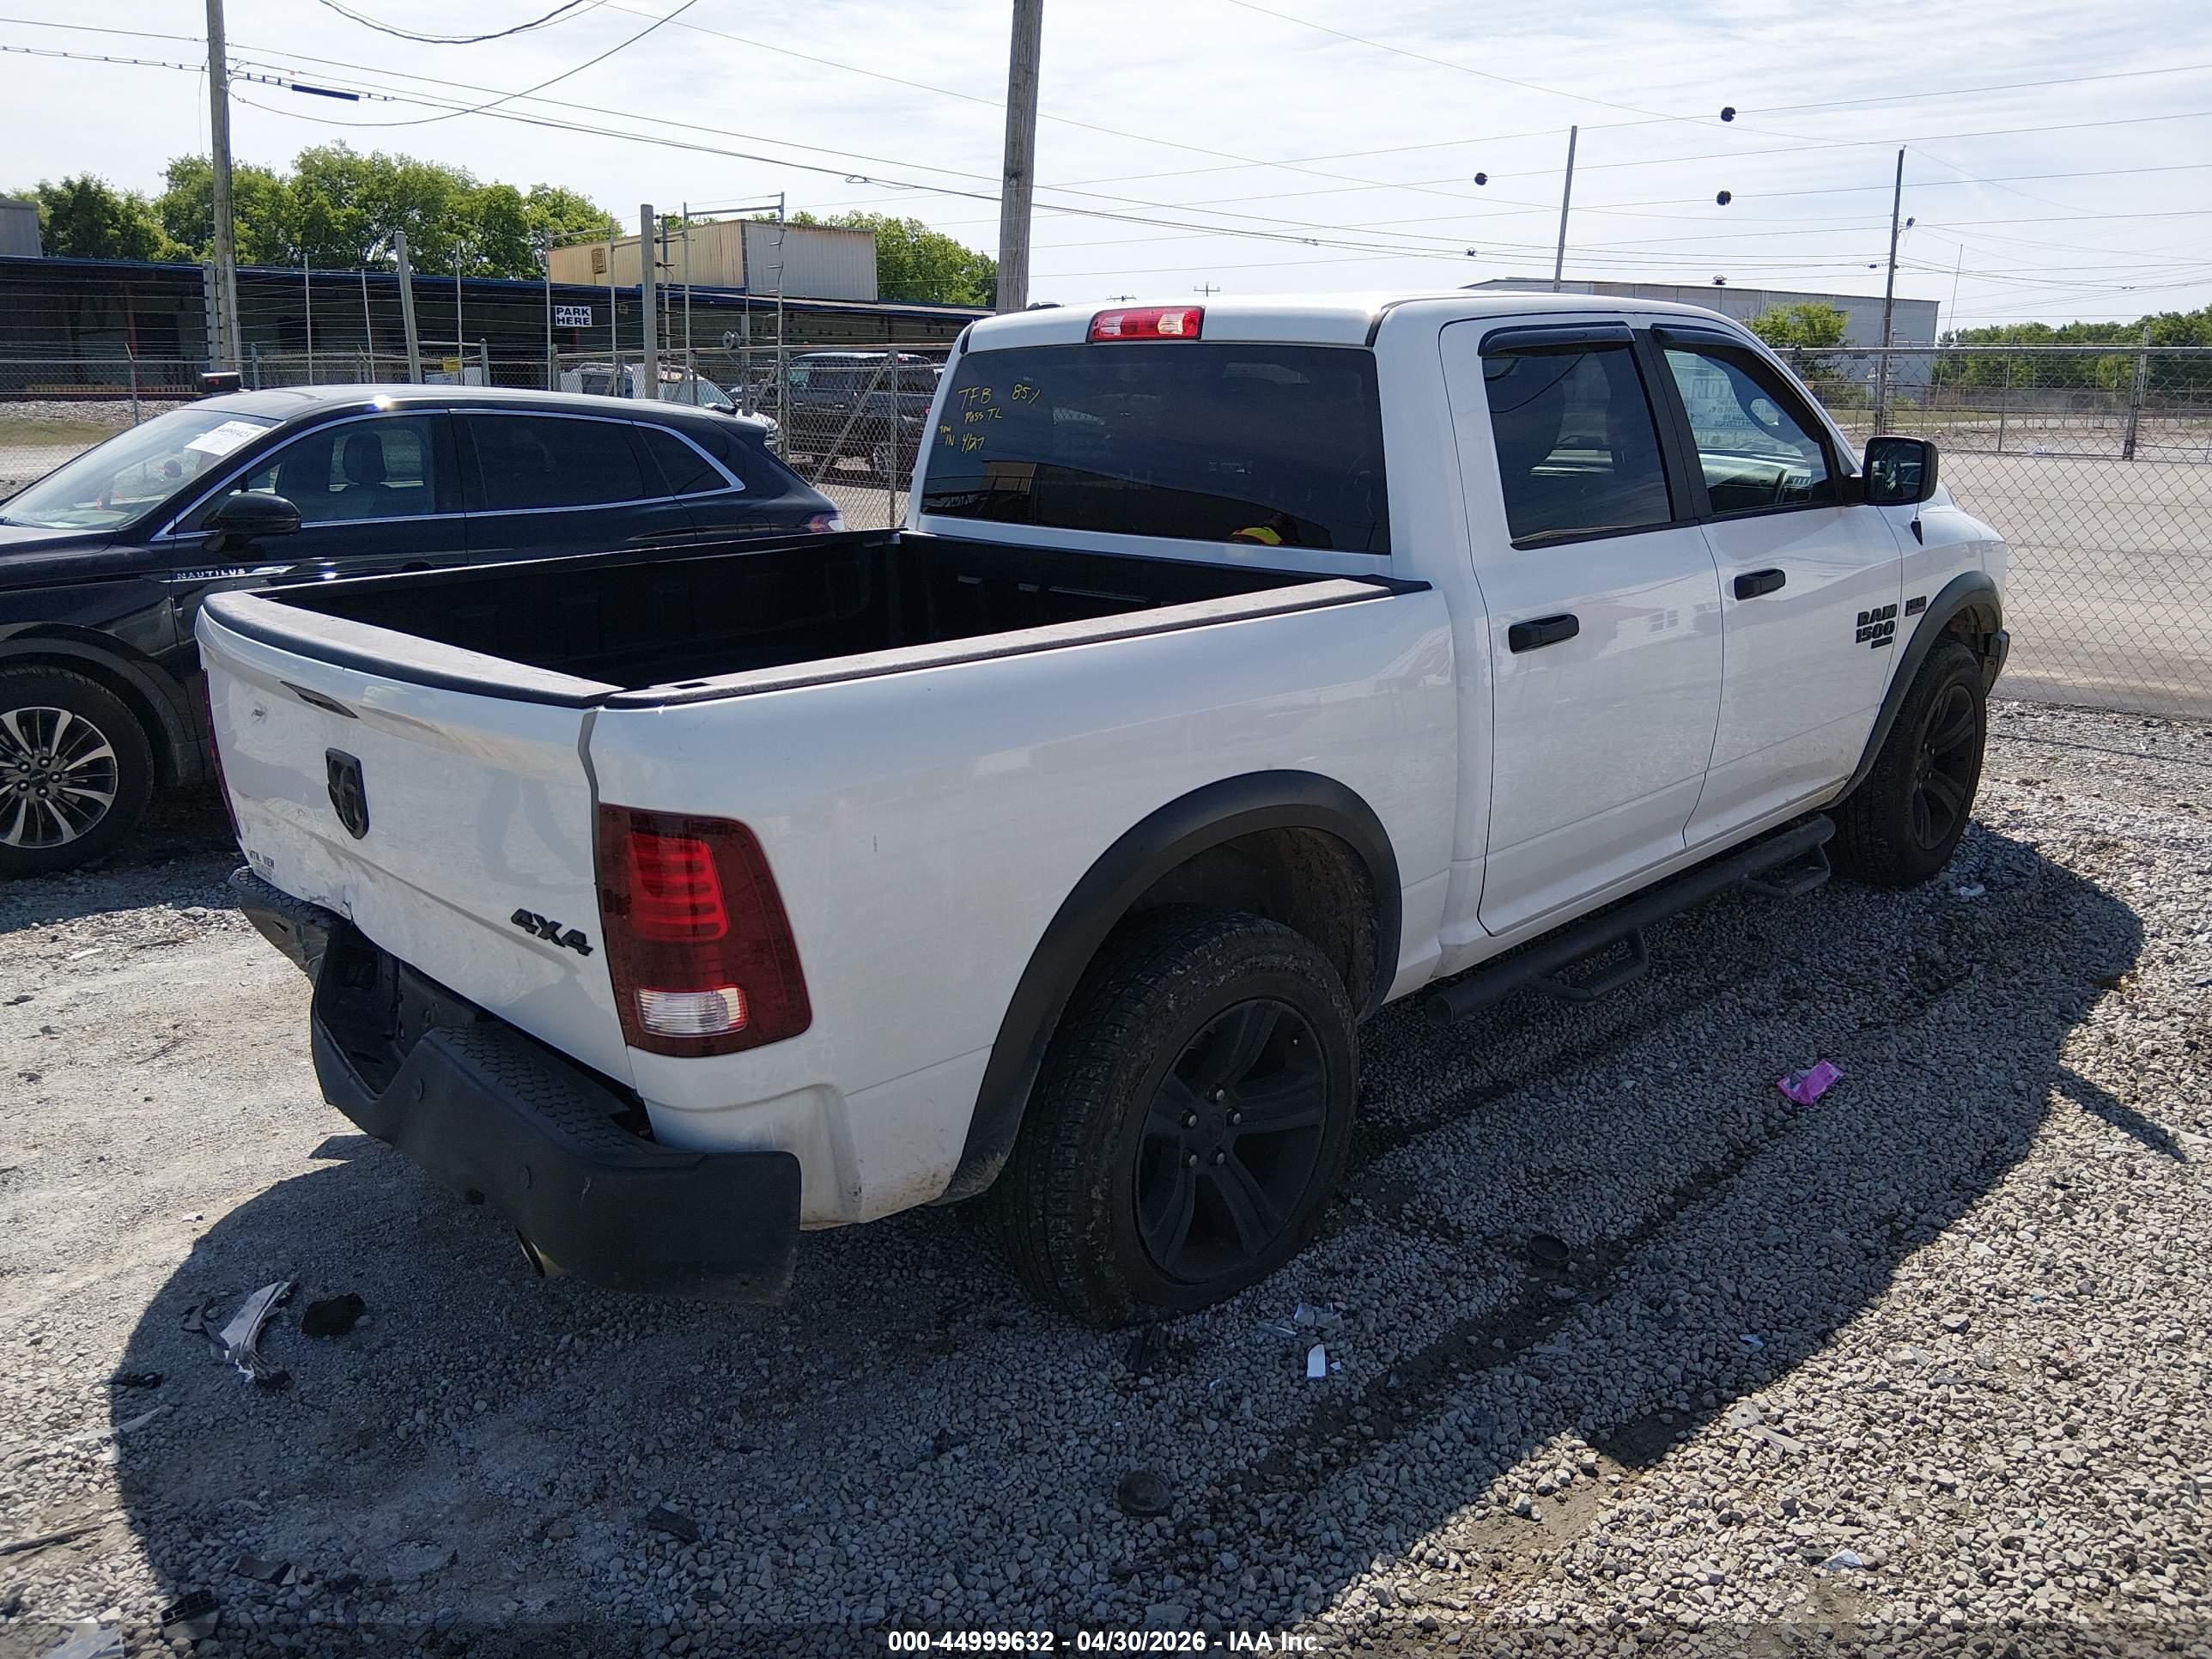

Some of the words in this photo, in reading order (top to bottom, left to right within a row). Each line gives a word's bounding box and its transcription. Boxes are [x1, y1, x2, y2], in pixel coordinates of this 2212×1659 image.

[556, 307, 590, 316] PARK
[556, 317, 591, 325] HERE
[958, 387, 992, 410] TFB
[176, 568, 246, 580] NAUTILUS
[1856, 604, 1898, 627] RAM
[1856, 620, 1895, 644] 1500
